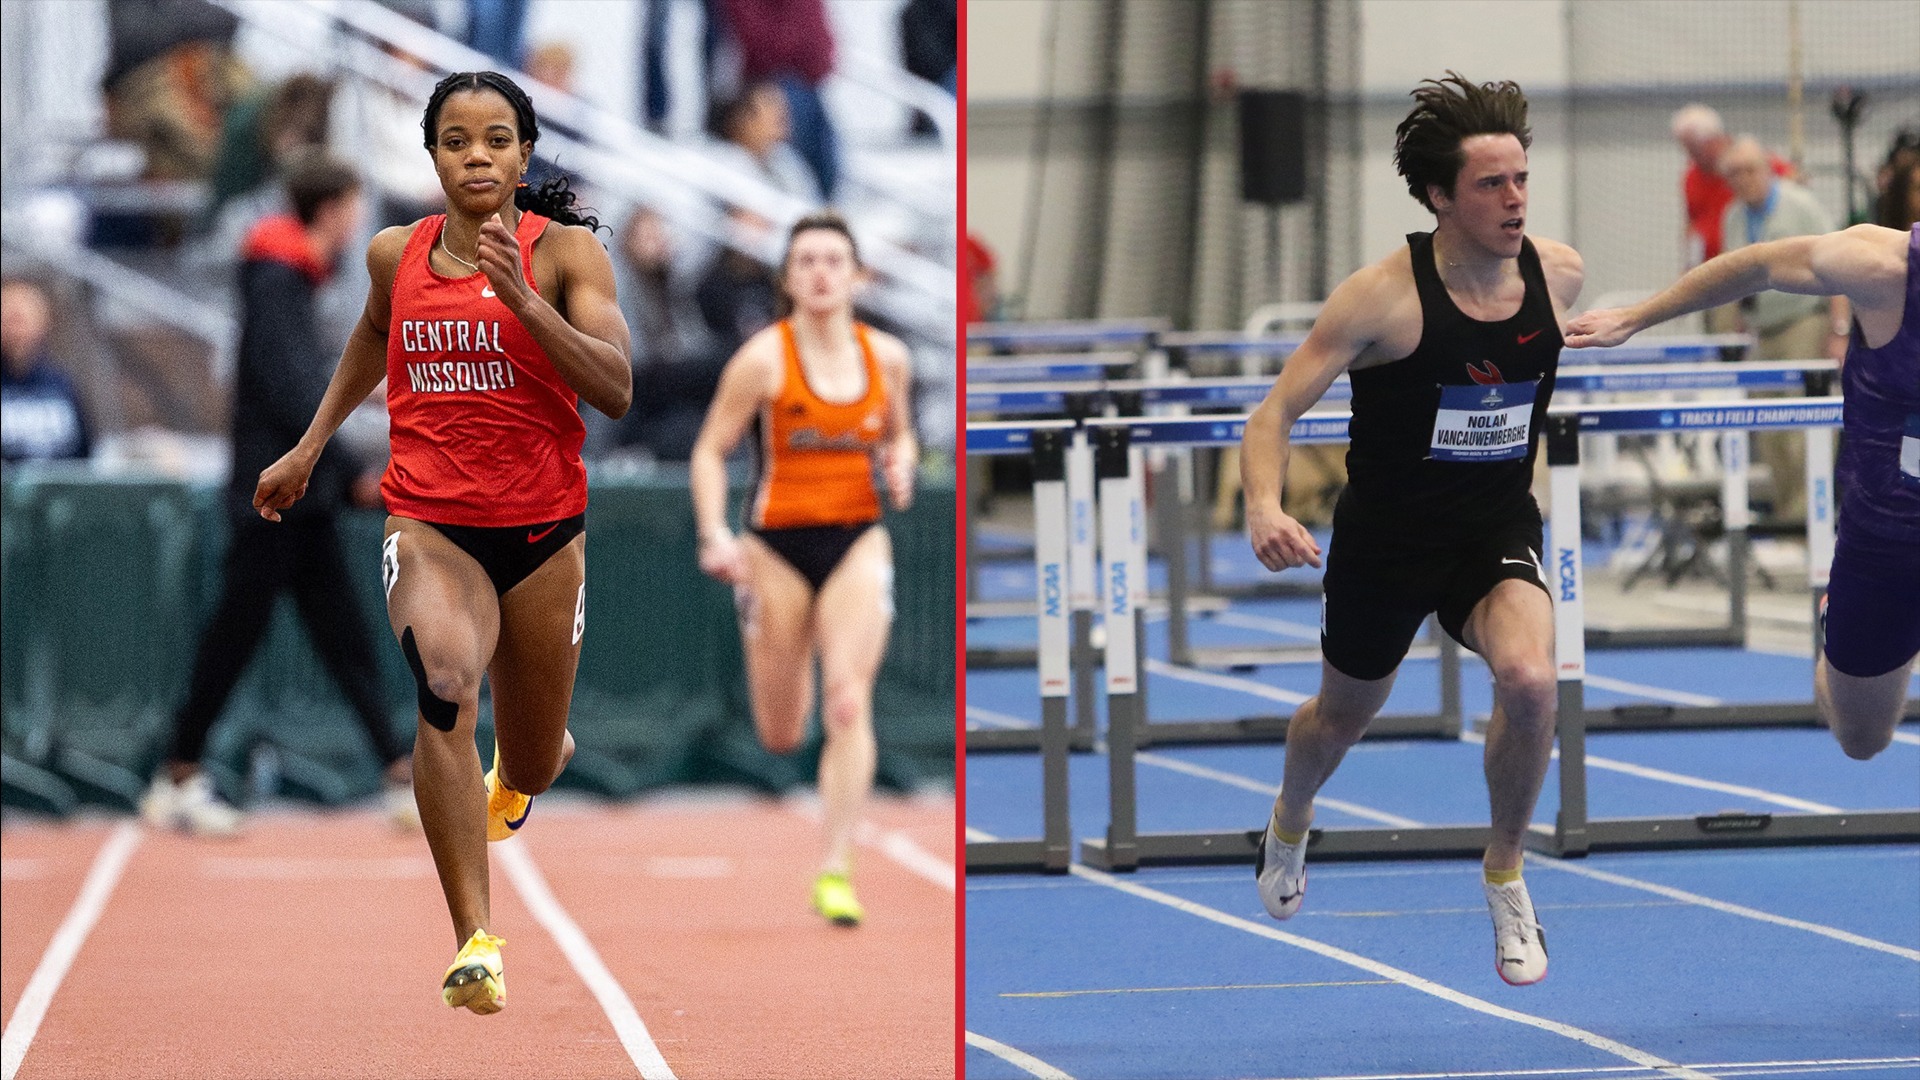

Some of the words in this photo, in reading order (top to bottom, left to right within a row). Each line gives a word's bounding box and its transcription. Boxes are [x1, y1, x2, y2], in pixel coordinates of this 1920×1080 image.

[402, 320, 505, 353] CENTRAL
[406, 360, 516, 393] MISSOURI
[1467, 413, 1508, 428] NOLAN
[1681, 411, 1715, 426] TRACK
[1726, 409, 1755, 424] FIELD
[1437, 424, 1527, 446] VANCAUWEMBERGHE
[1043, 562, 1061, 618] NCAA
[1111, 560, 1128, 616] NCAA
[1559, 547, 1577, 602] NCAA
